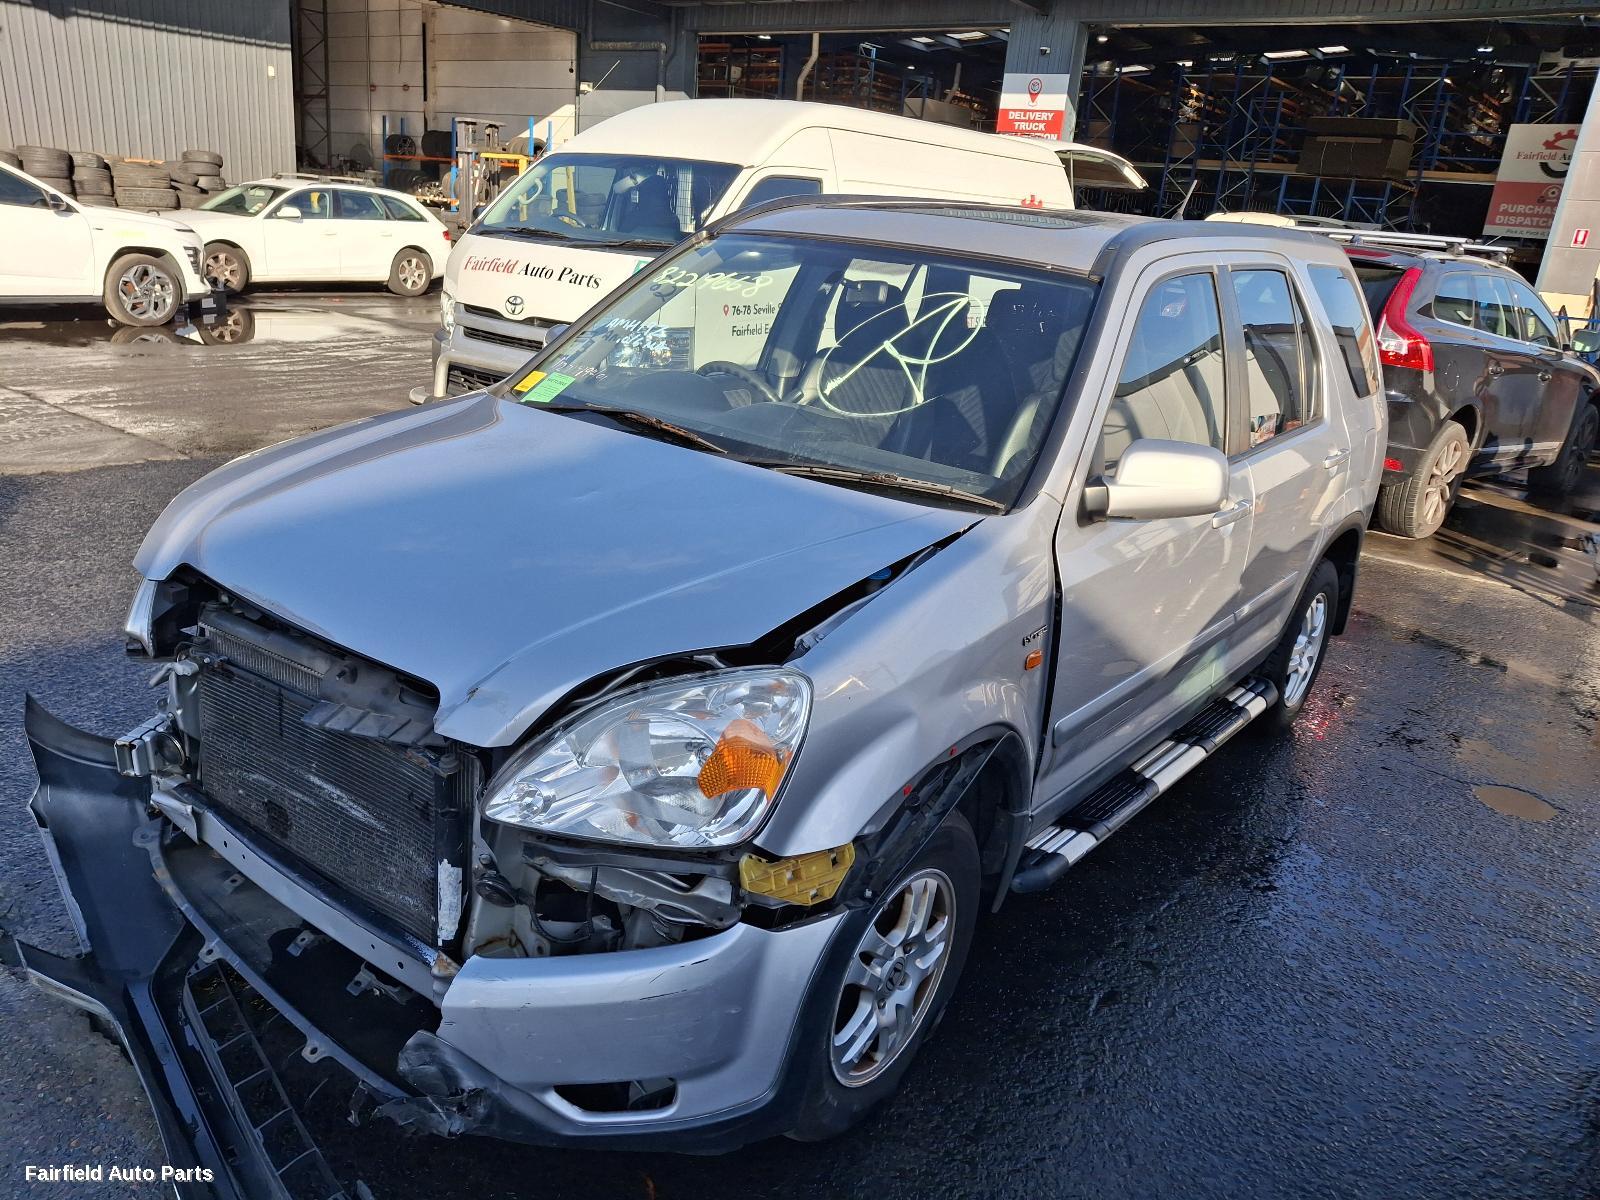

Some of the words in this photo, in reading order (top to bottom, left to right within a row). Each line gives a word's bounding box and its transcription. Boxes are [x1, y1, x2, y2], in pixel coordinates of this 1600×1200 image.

[1009, 111, 1054, 120] DELIVERY
[1014, 122, 1045, 130] TRUCK
[1516, 152, 1557, 161] Fairfield
[463, 255, 519, 274] Fairfield
[517, 261, 554, 280] Auto
[557, 265, 602, 289] Parts
[731, 305, 752, 316] 76-78
[753, 302, 776, 315] Seville
[731, 323, 762, 337] Fairfield
